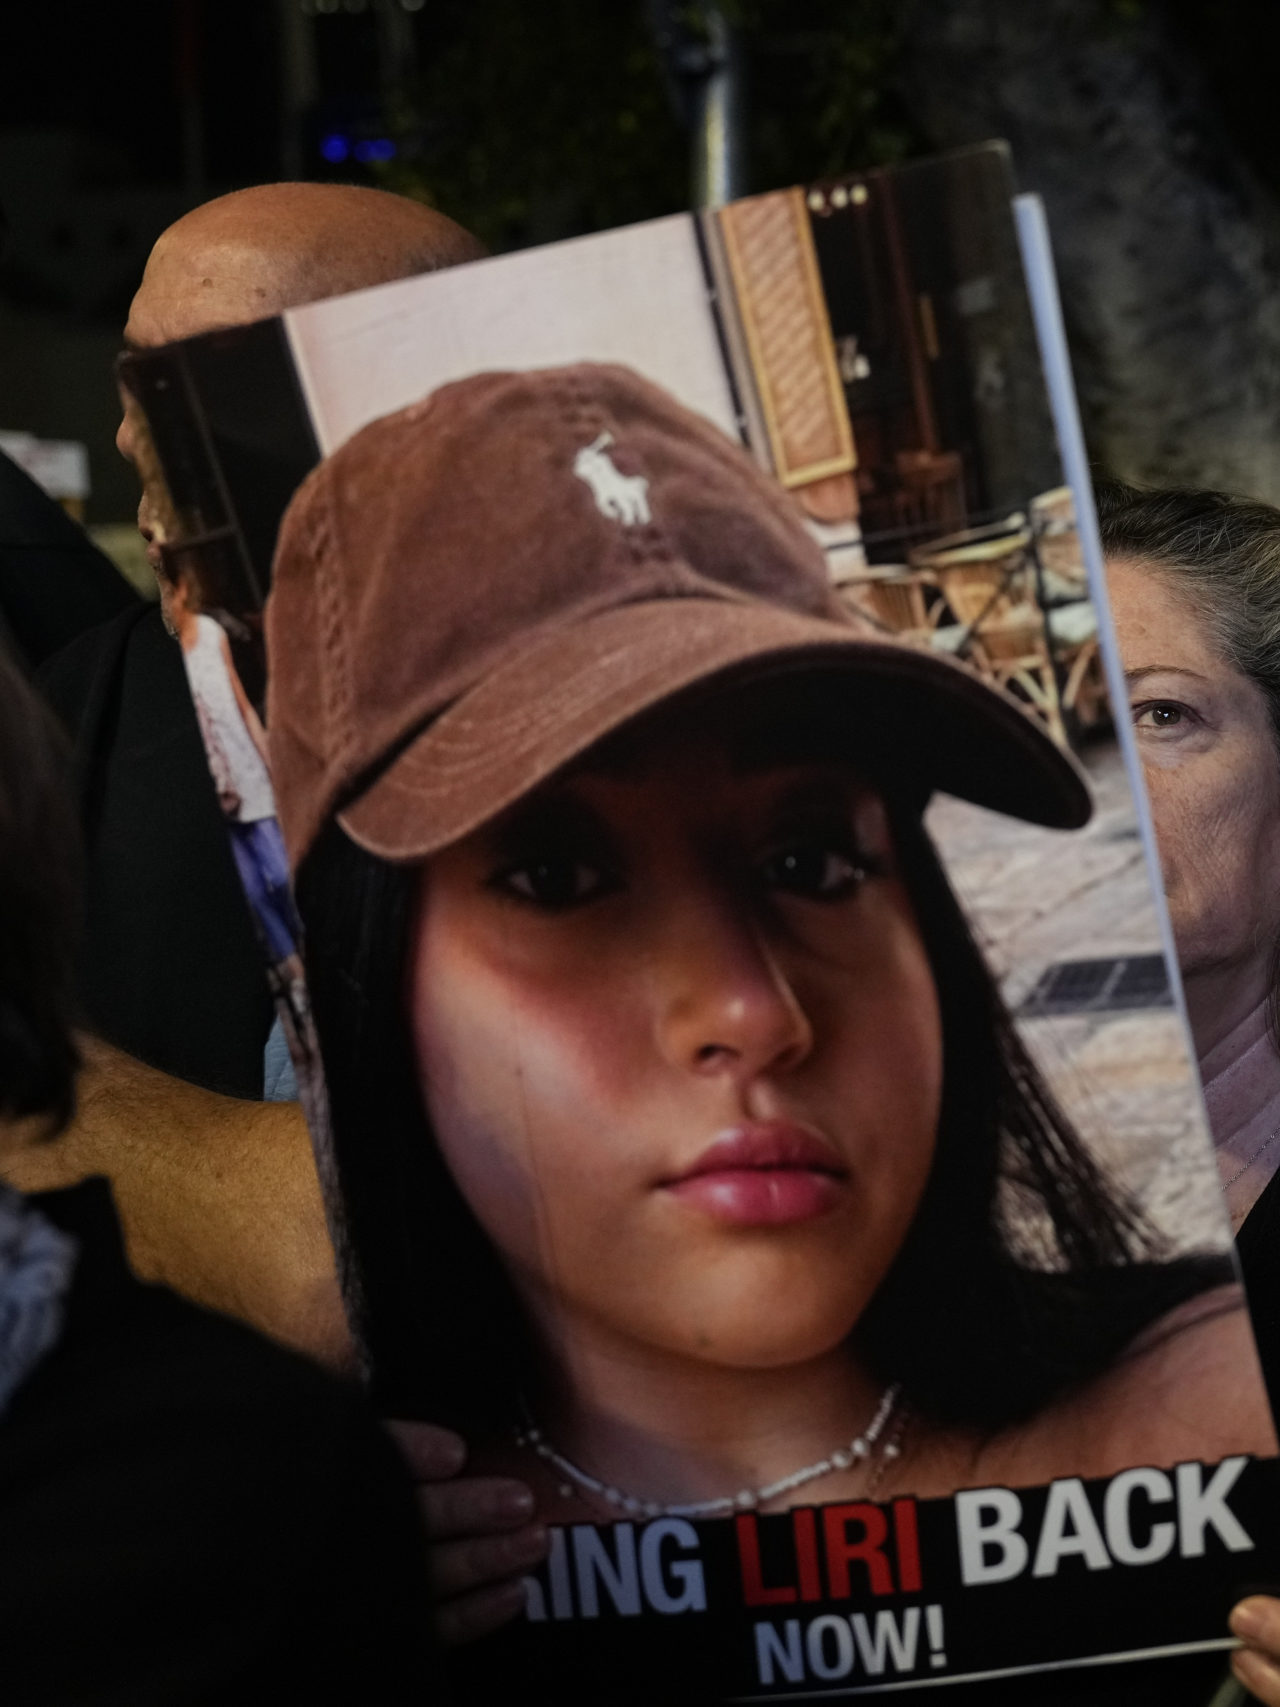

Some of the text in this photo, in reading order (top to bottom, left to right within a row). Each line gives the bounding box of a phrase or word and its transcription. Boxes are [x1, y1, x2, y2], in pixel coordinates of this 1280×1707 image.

[734, 1499, 922, 1606] LIRI
[955, 1456, 1254, 1586] BACK
[753, 1603, 947, 1685] NOW!
